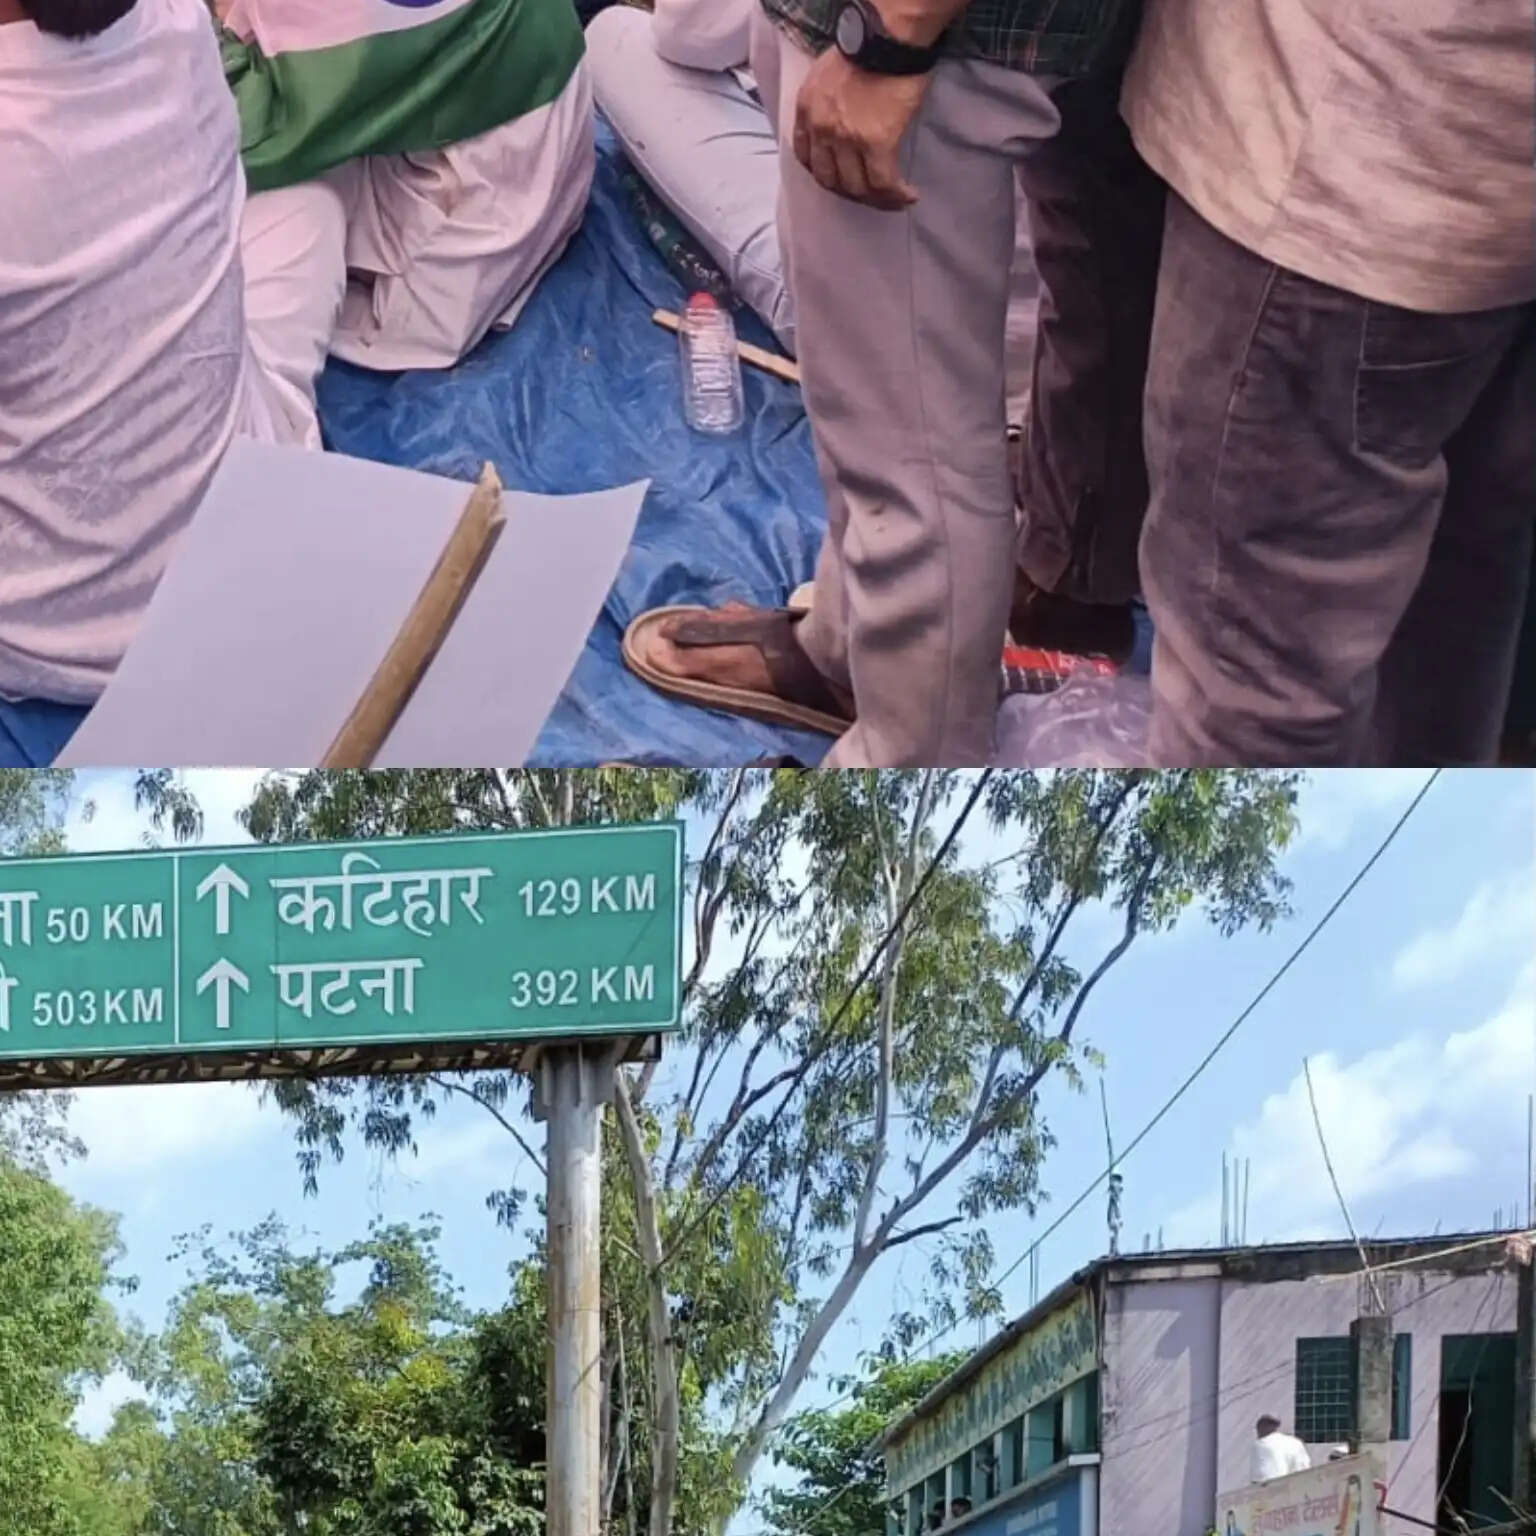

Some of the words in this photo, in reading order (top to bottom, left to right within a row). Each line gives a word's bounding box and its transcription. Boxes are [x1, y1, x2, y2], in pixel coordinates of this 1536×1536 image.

[270, 852, 494, 935] कटिहार
[519, 878, 583, 917] 129
[592, 873, 655, 912] KM
[47, 910, 88, 945] 50
[104, 902, 163, 939] KM
[33, 990, 98, 1027] 503
[104, 986, 163, 1023] KM
[270, 958, 424, 1017] पटना
[510, 969, 578, 1007] 392
[592, 963, 654, 1002] KM
